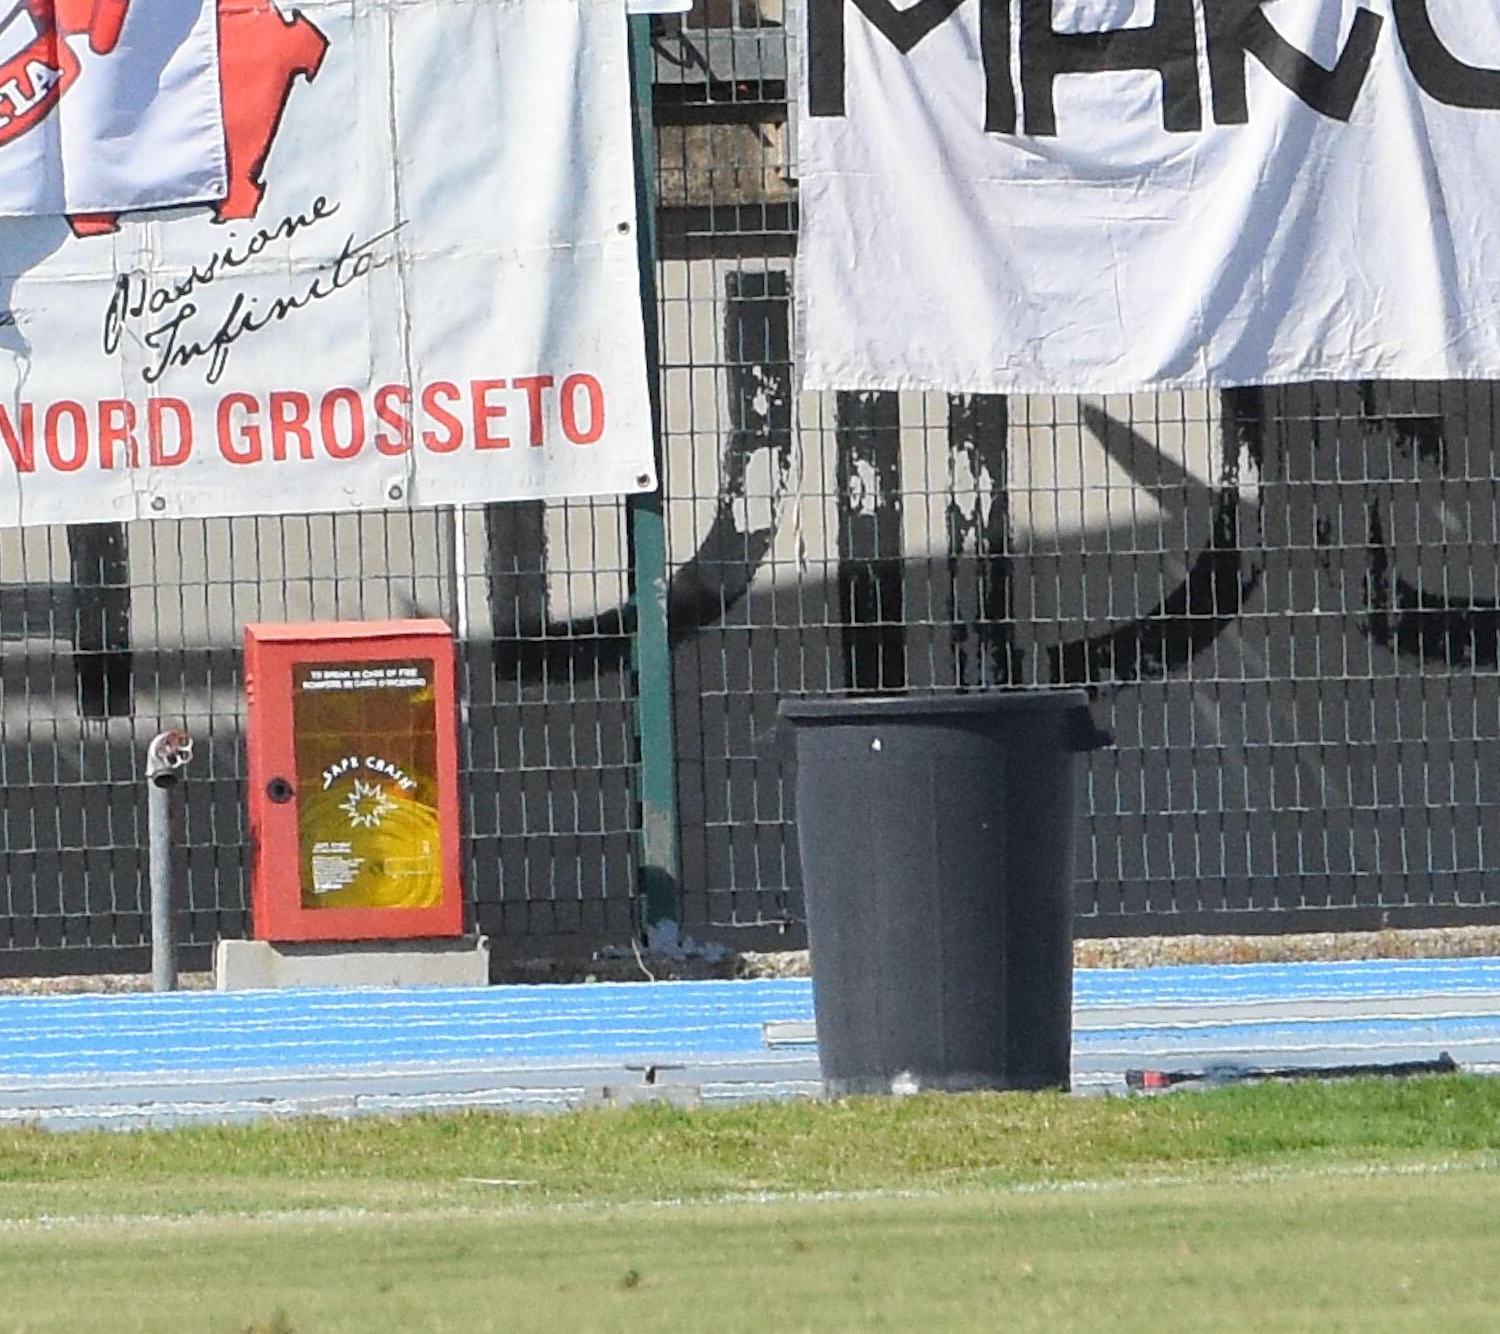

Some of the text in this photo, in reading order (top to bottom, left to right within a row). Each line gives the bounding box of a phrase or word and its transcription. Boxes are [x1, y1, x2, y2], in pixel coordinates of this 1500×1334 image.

[103, 195, 340, 355] Passione
[143, 219, 410, 383] Infinita
[216, 372, 608, 466] GROSSETO
